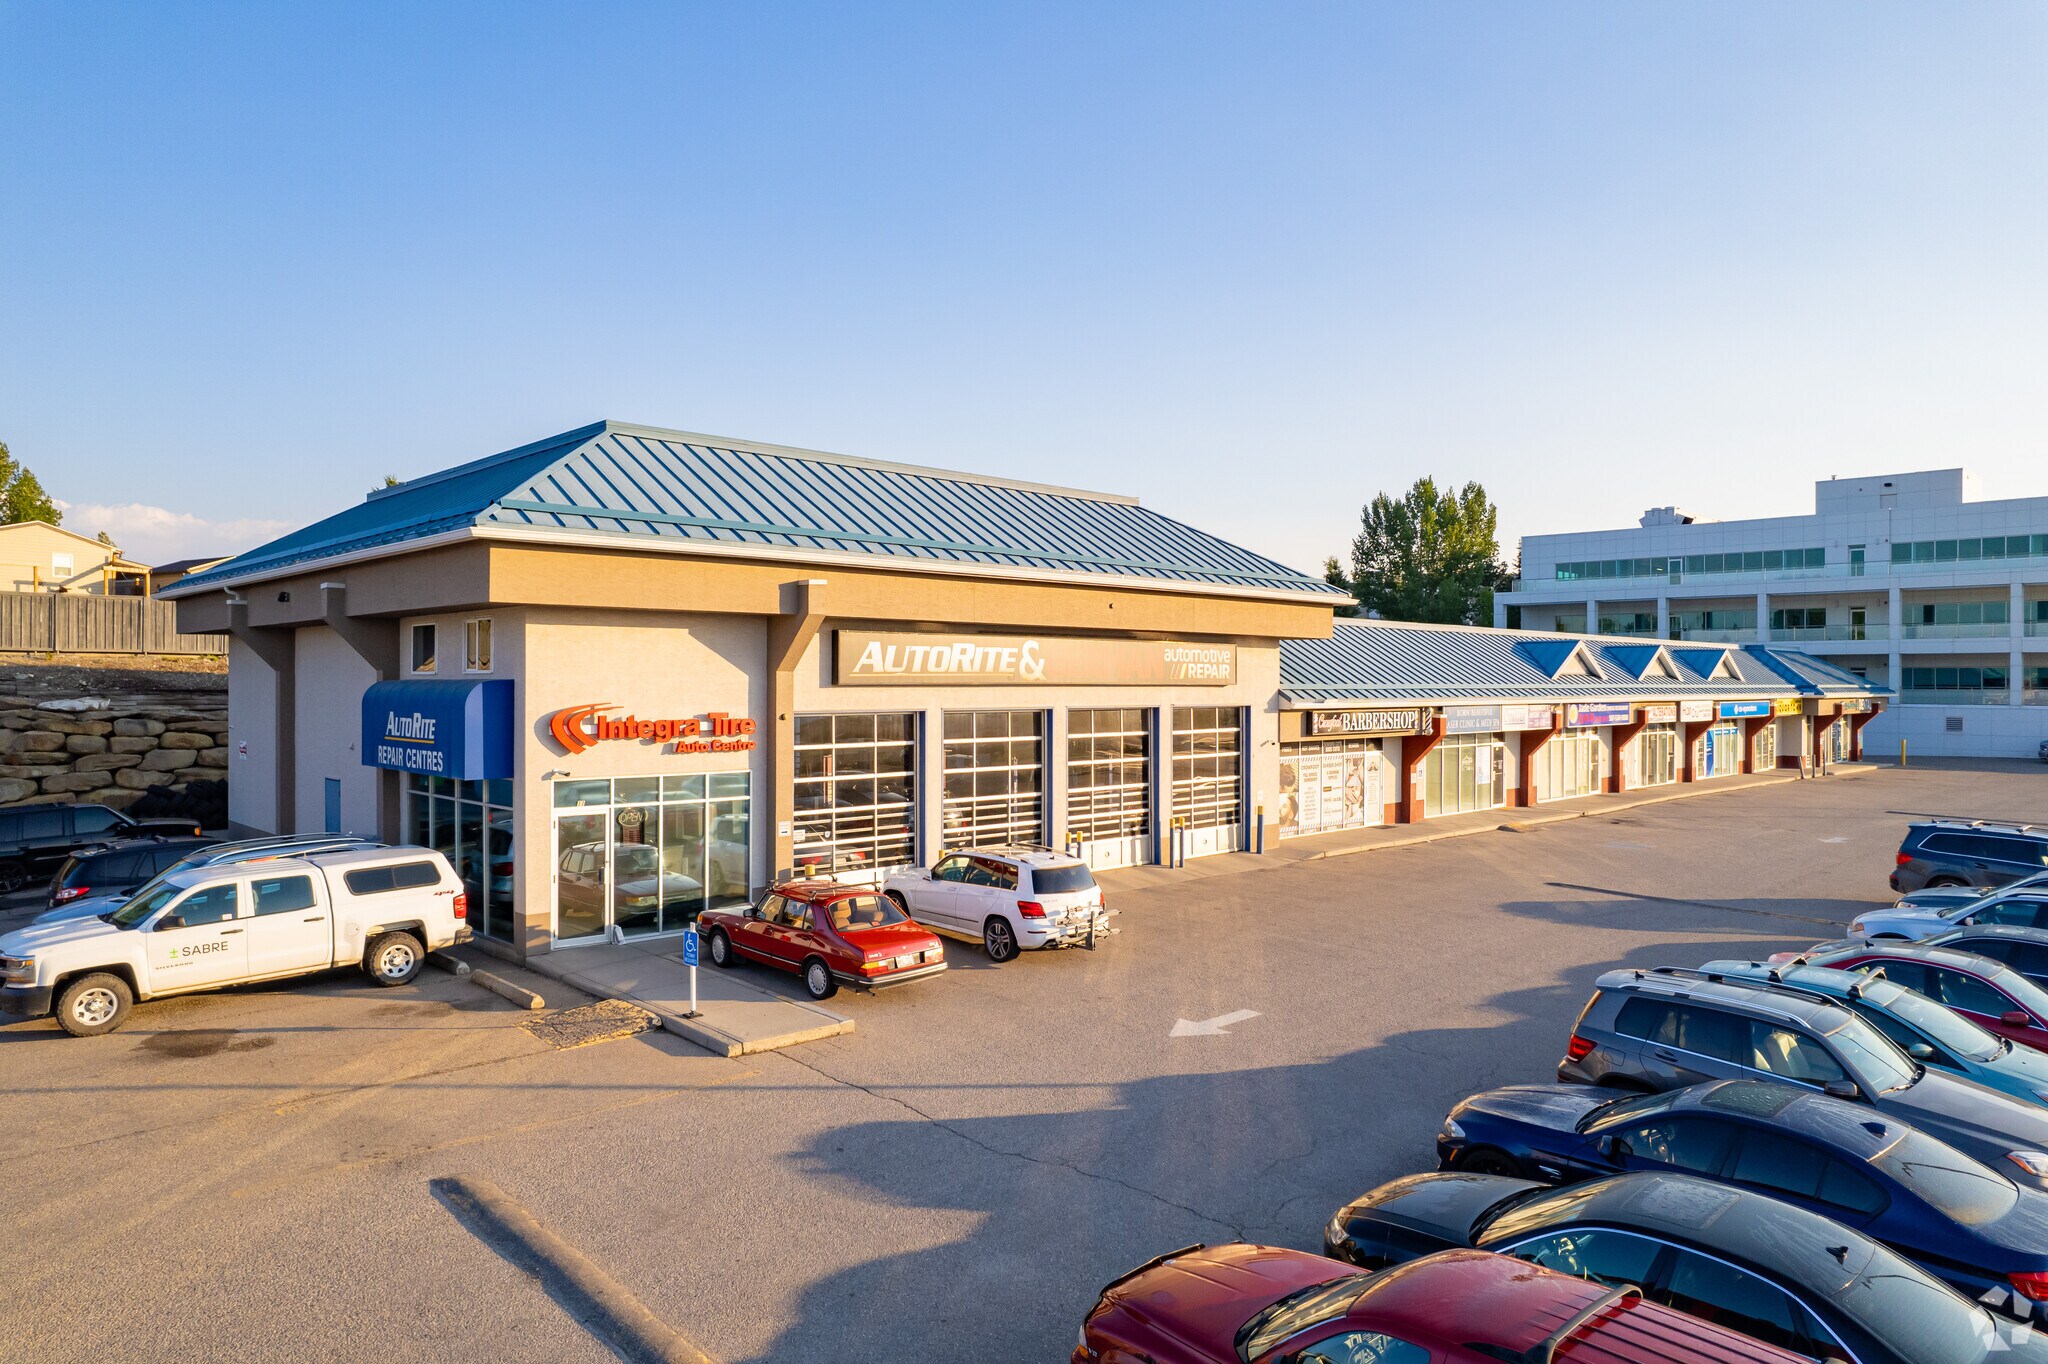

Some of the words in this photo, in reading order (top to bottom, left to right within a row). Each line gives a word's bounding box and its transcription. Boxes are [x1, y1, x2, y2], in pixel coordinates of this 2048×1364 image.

[1164, 647, 1231, 663] automotive
[1187, 664, 1231, 680] REPAIR
[1456, 708, 1470, 717] BORN
[597, 714, 701, 743] Integra
[708, 712, 757, 736] Tire
[1342, 711, 1416, 731] BARBERSHOP
[1447, 719, 1459, 729] ASER
[1459, 719, 1476, 728] CLINIC
[676, 740, 709, 754] Auto
[712, 739, 757, 752] Centre
[378, 747, 404, 767] REPAIR
[405, 749, 444, 773] CENTRES
[620, 811, 644, 823] OPEN
[182, 940, 229, 957] SABRE
